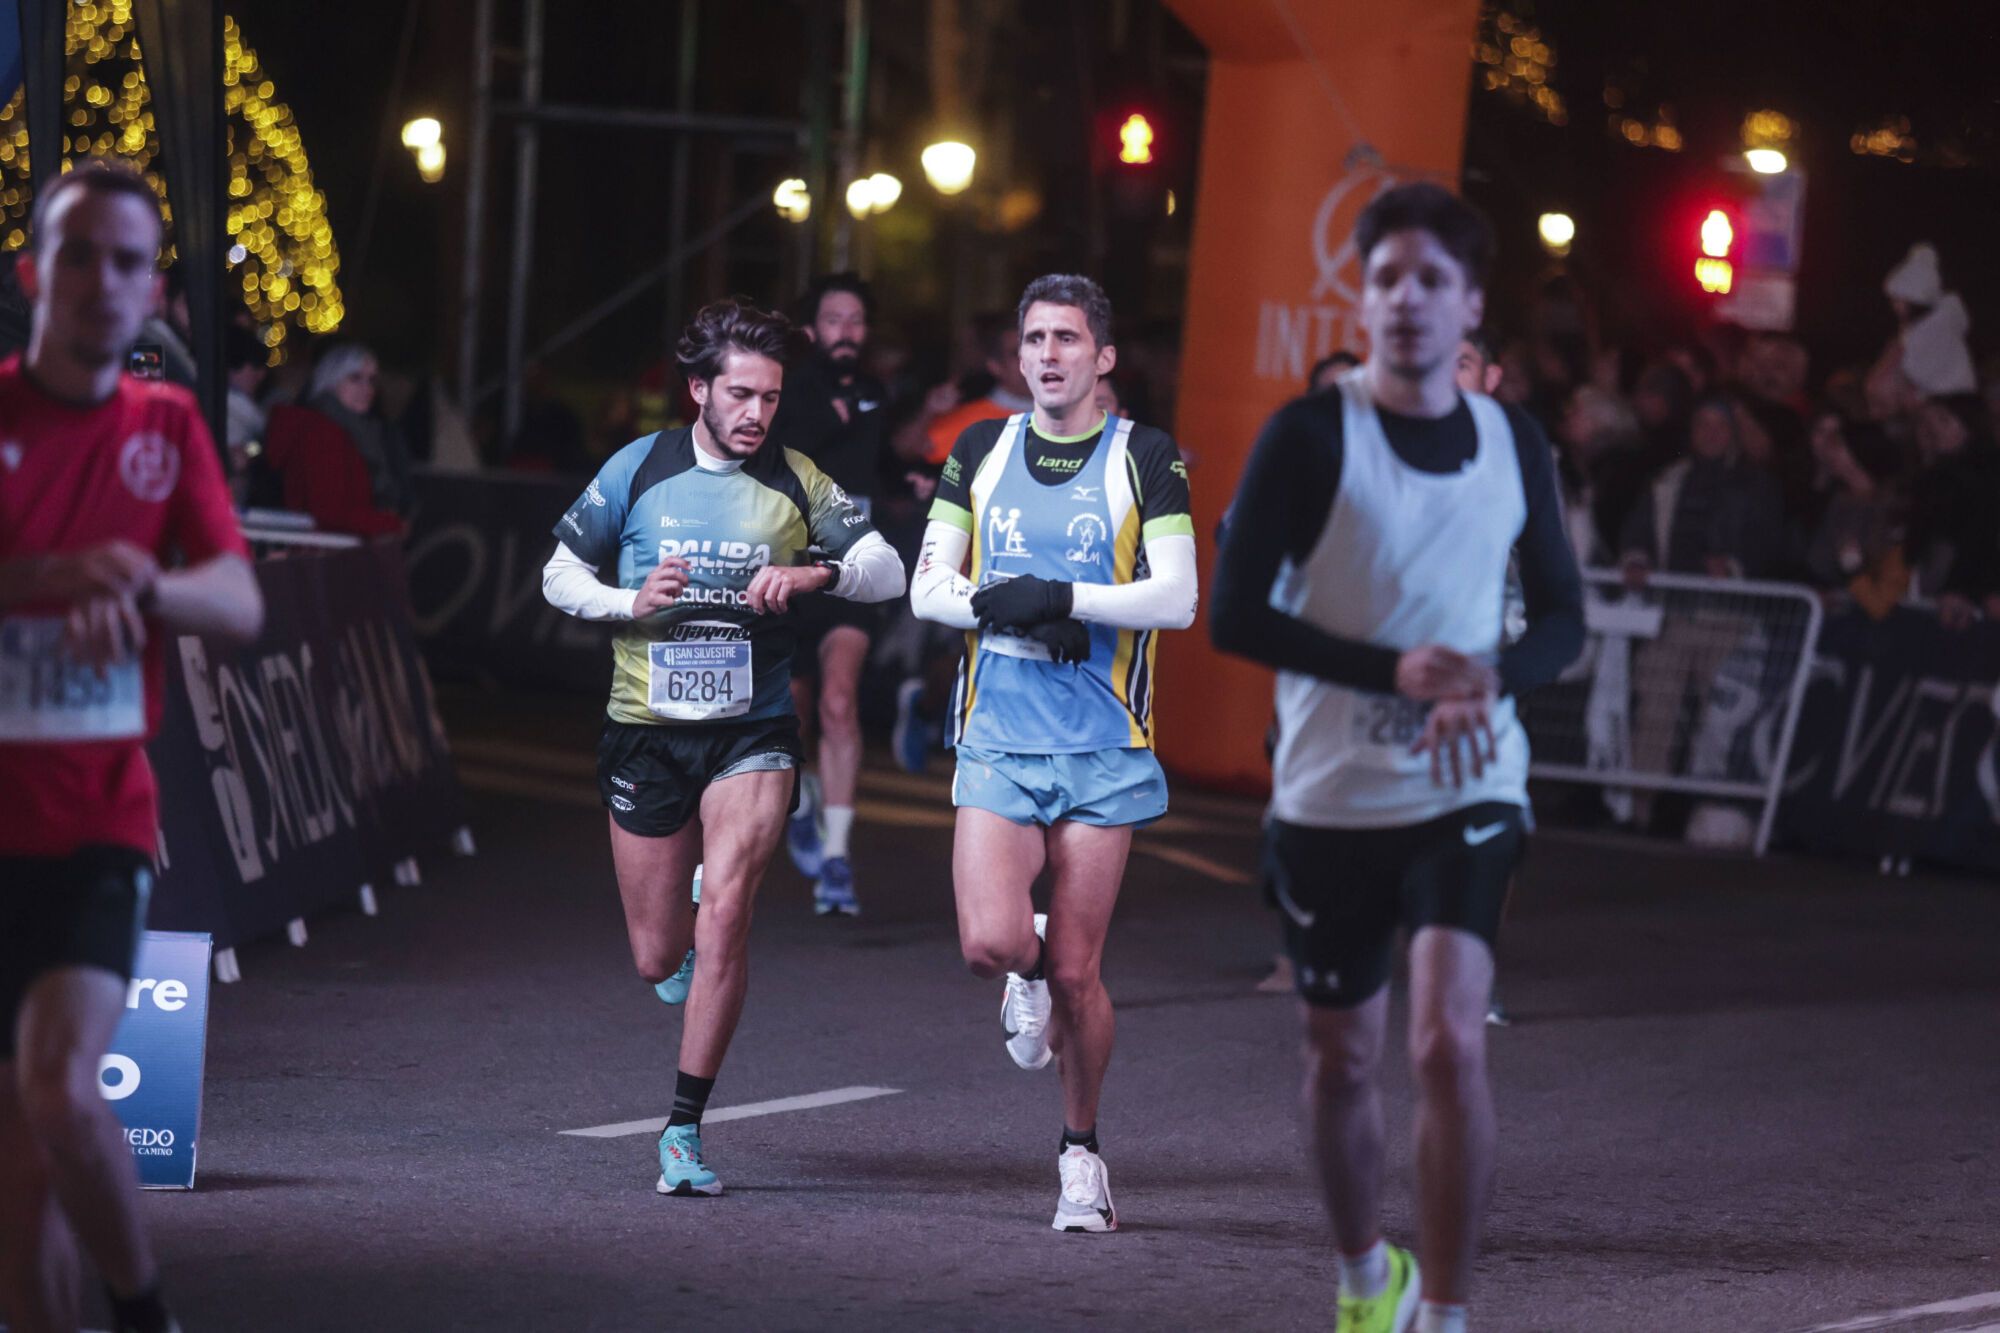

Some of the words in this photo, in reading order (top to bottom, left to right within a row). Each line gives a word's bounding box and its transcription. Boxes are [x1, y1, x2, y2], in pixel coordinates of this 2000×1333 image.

[674, 586, 748, 606] aucho
[663, 647, 675, 666] 41
[675, 647, 693, 659] SAN
[694, 646, 736, 659] SILVESTRE
[667, 669, 734, 702] 6284
[137, 1147, 172, 1156] CAMINO
